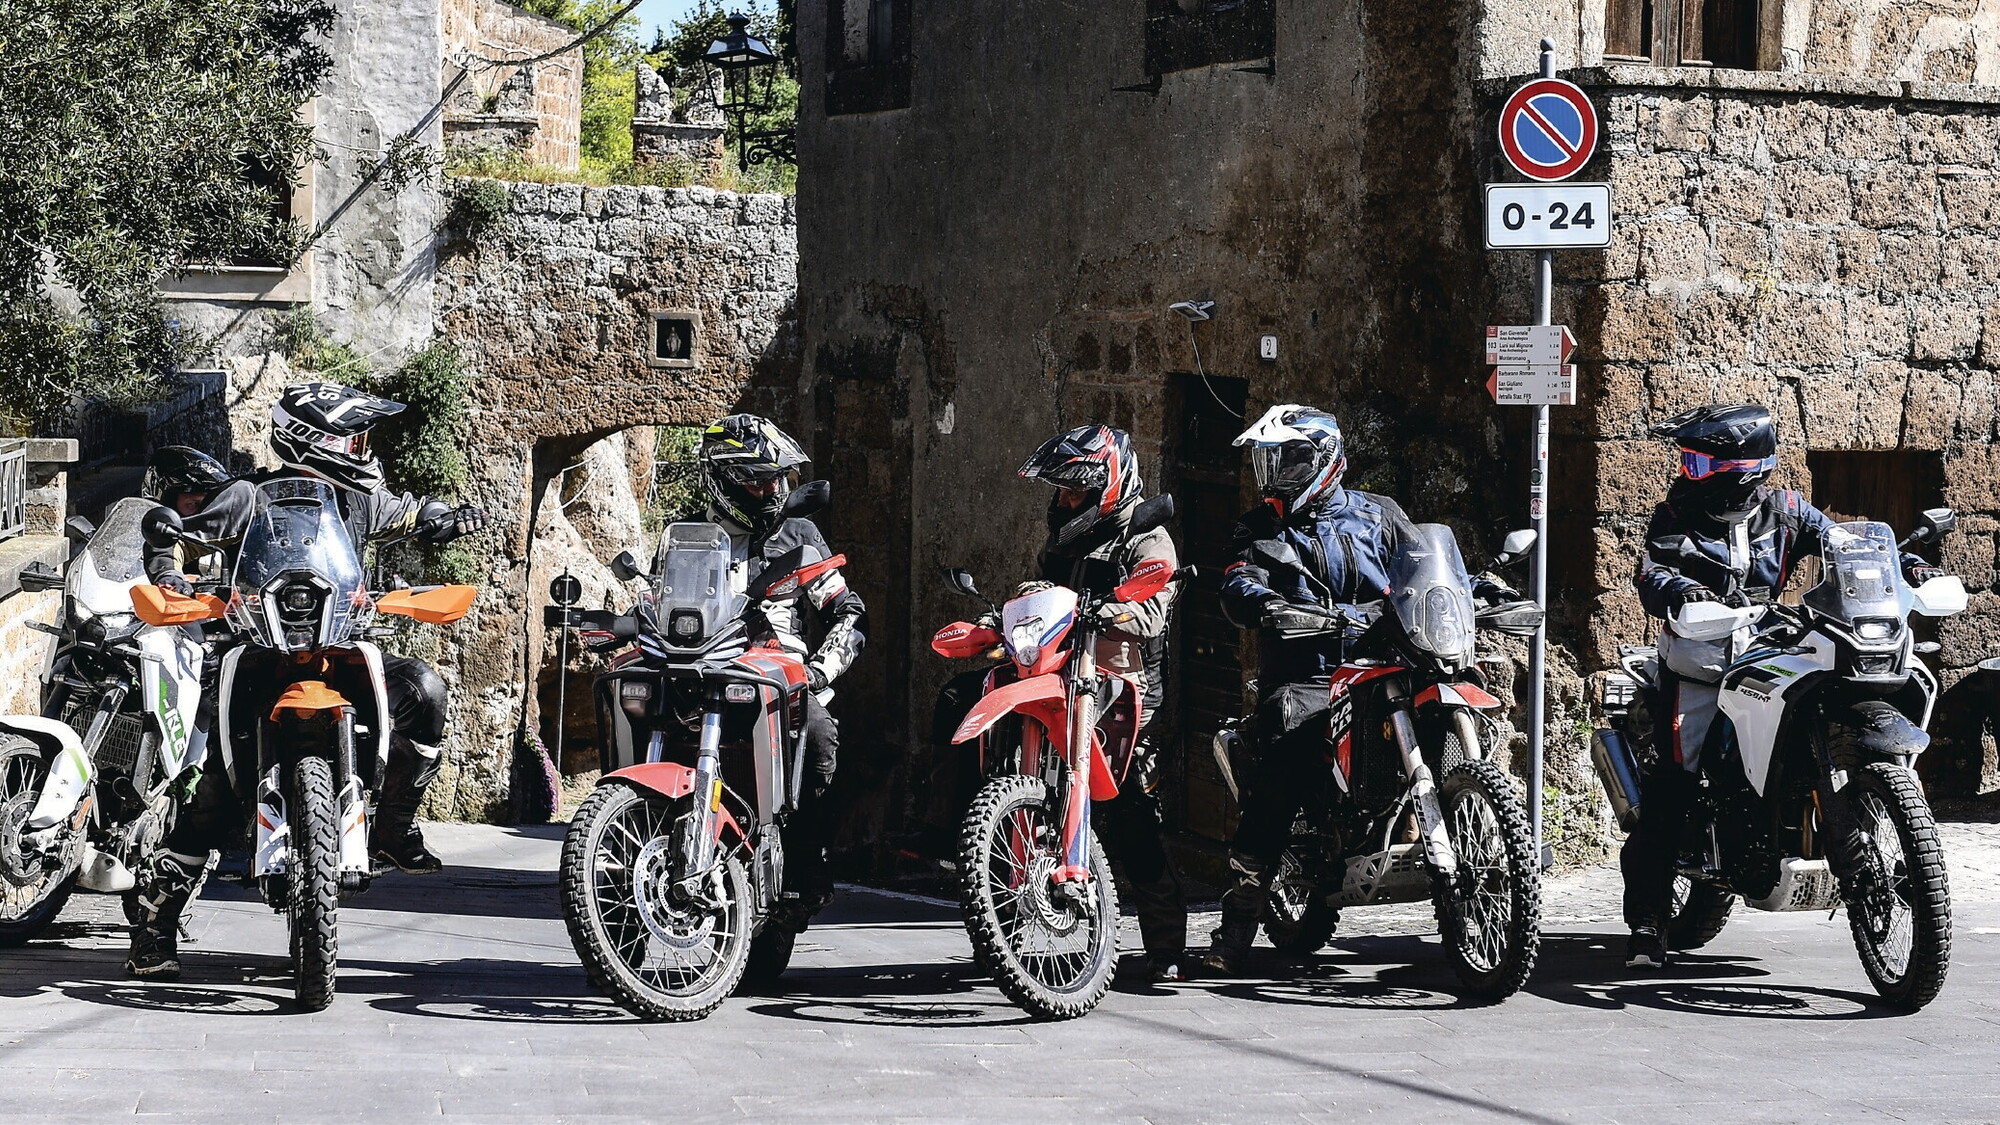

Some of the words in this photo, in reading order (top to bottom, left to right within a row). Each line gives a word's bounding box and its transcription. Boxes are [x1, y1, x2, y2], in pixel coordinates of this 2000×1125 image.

[1266, 338, 1272, 356] 2
[1487, 341, 1497, 349] 103
[1131, 562, 1164, 580] HONDA
[934, 629, 968, 640] HONDA
